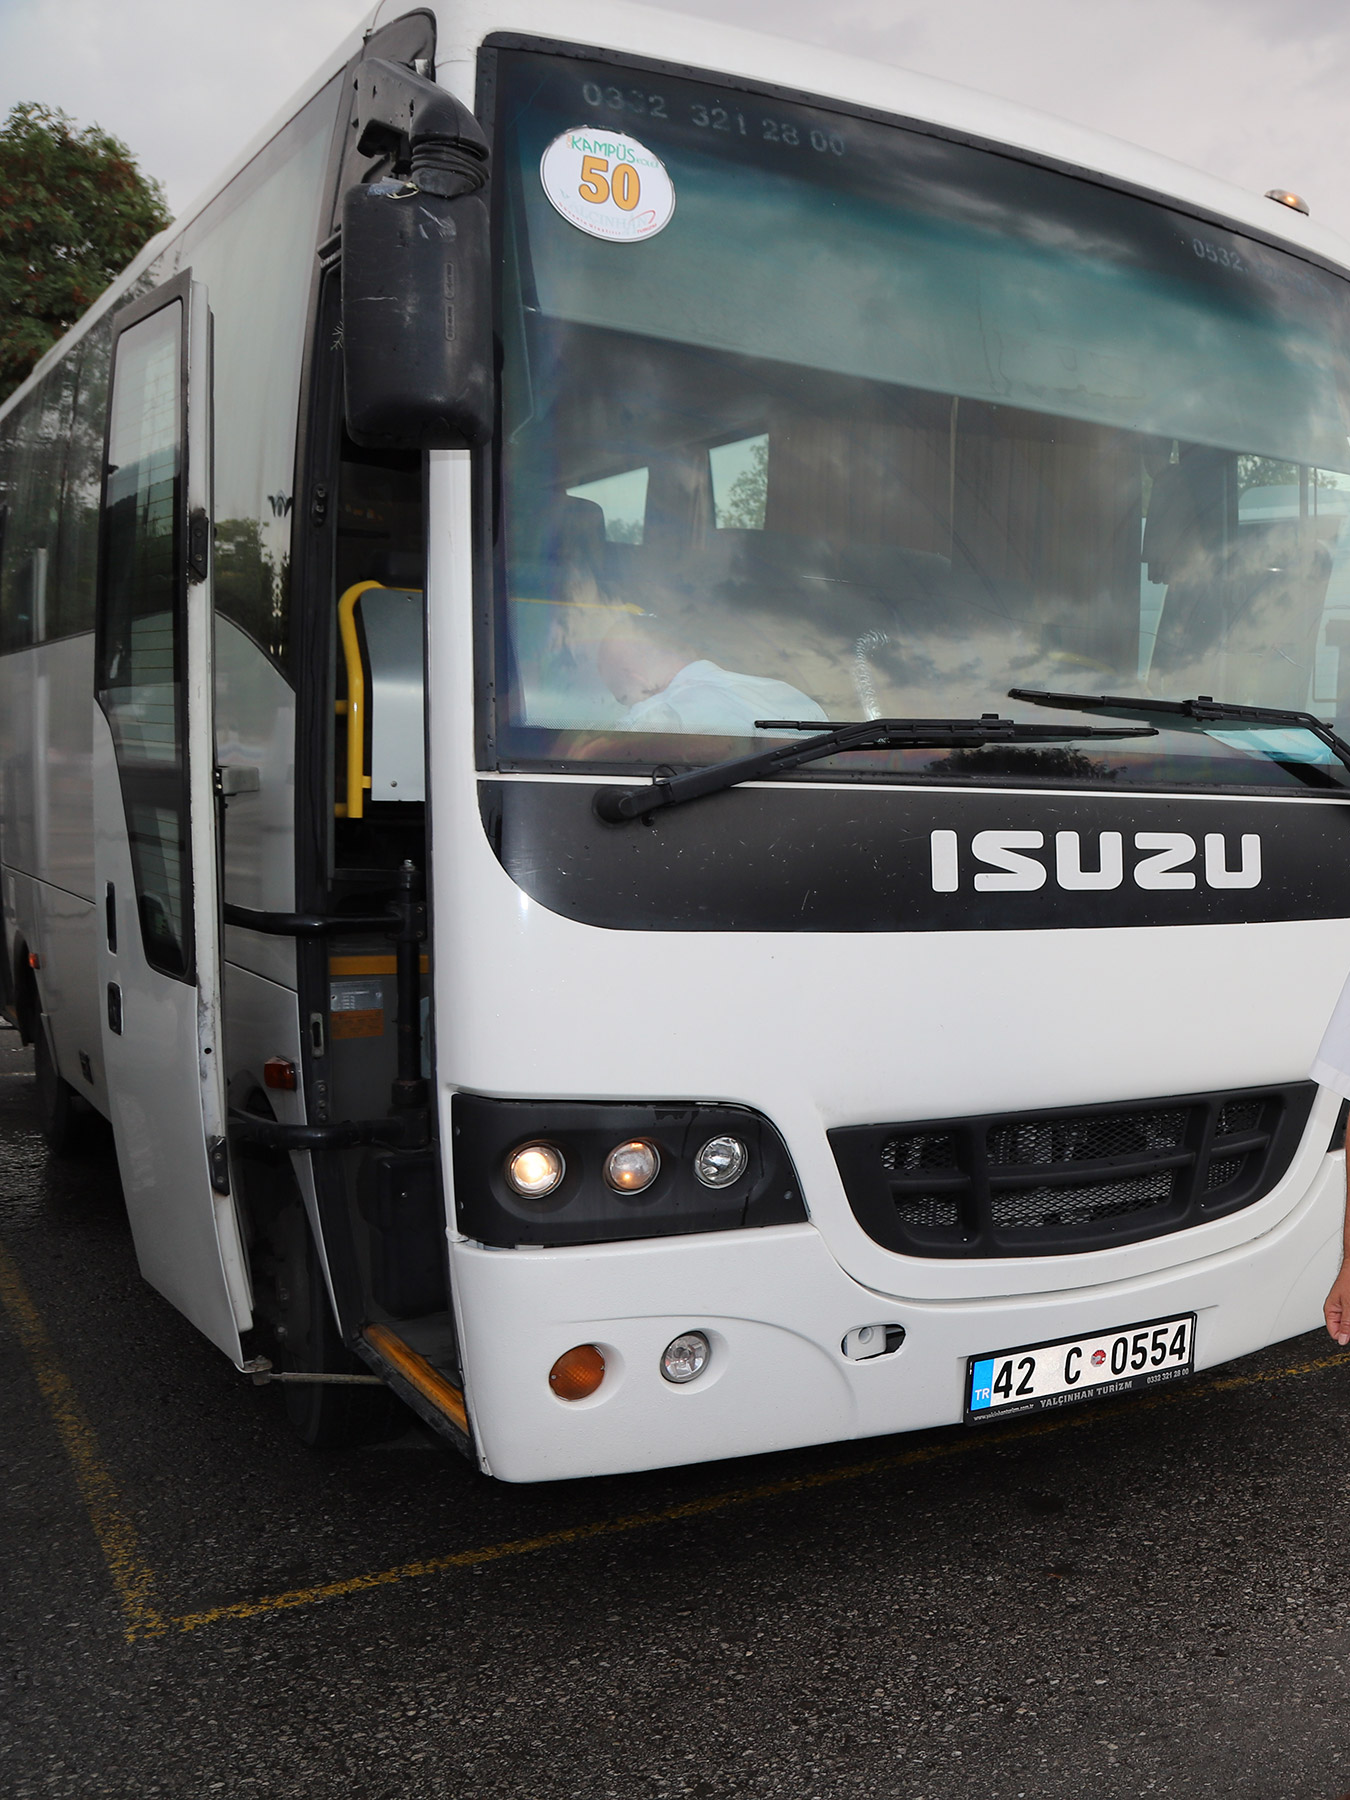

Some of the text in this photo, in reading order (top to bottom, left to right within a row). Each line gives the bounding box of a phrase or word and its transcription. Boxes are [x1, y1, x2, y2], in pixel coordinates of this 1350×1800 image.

[571, 135, 635, 163] KAMPÜS
[810, 129, 846, 157] 00
[578, 154, 641, 212] 50
[930, 829, 1263, 892] ISUZU
[993, 1324, 1186, 1398] 42 C 0554
[975, 1387, 990, 1401] TR
[1040, 1380, 1133, 1408] YALÇINHAN TURİZM
